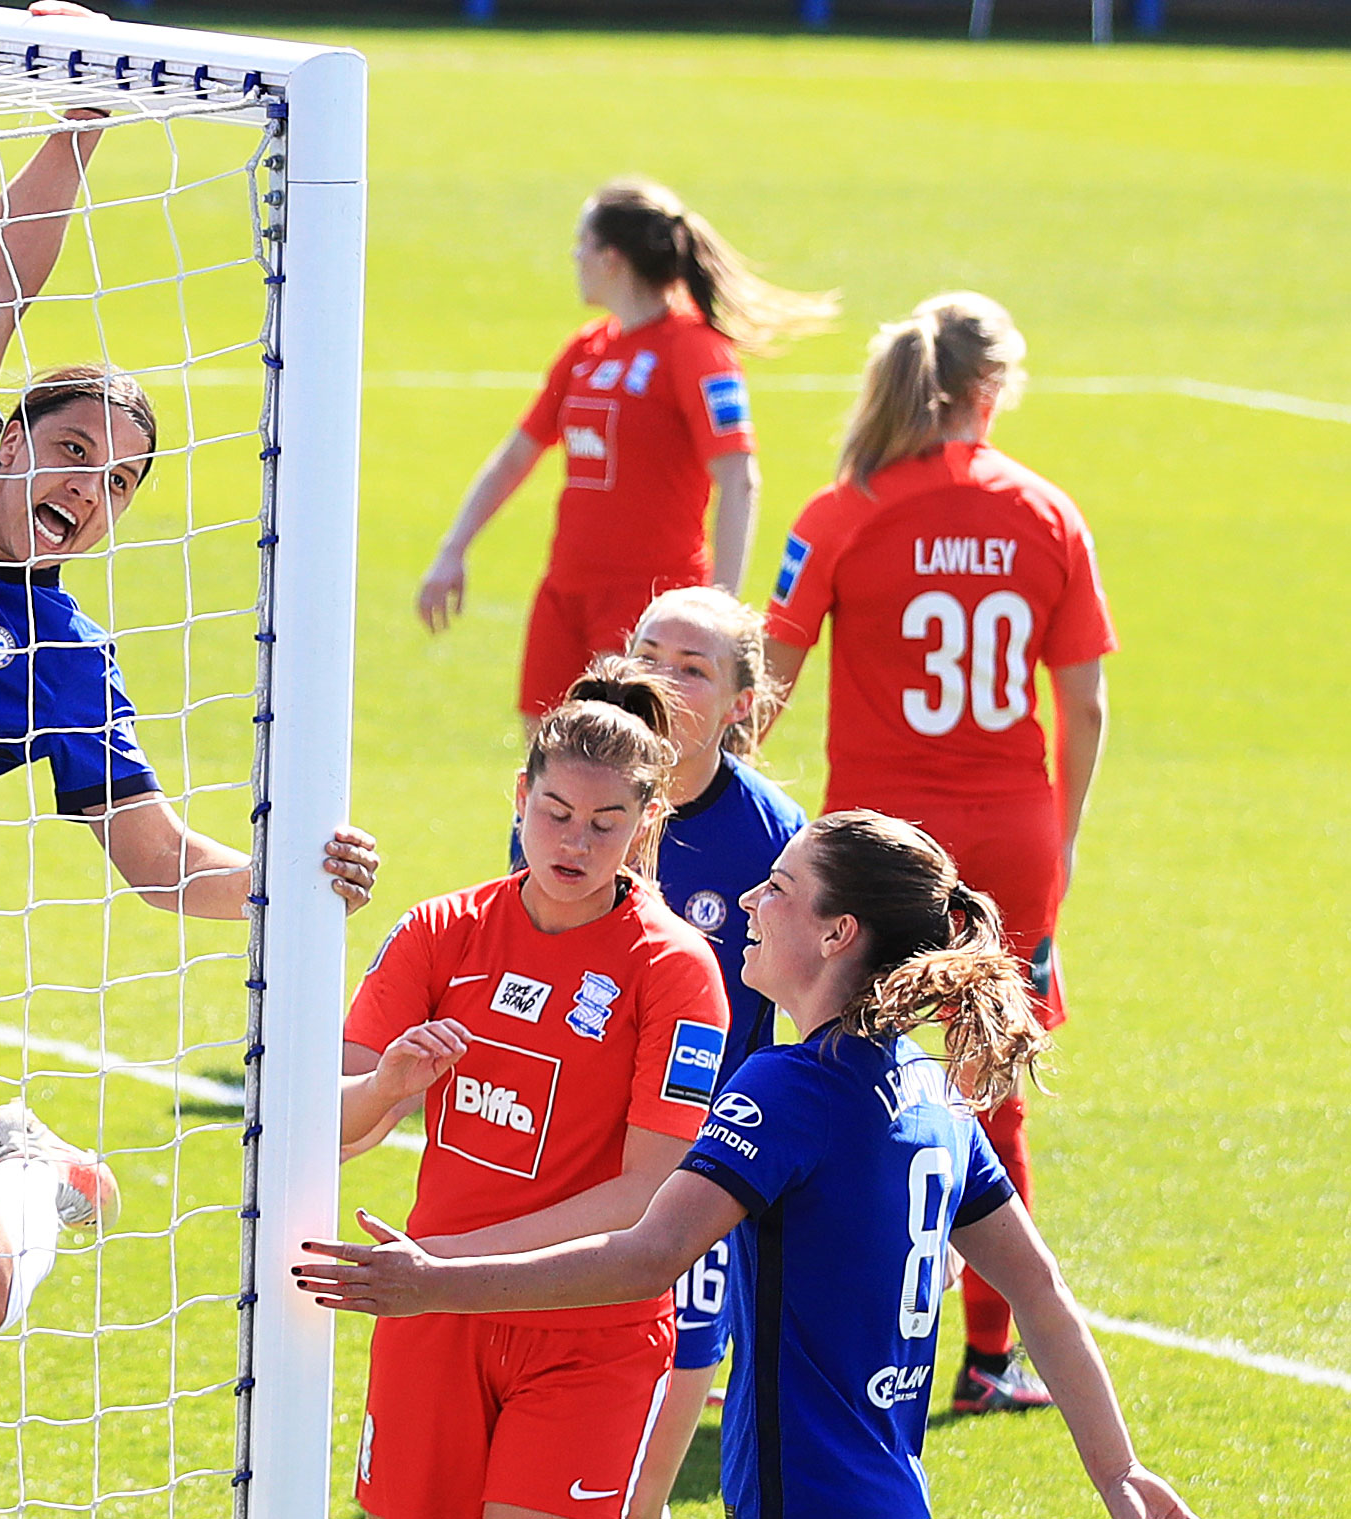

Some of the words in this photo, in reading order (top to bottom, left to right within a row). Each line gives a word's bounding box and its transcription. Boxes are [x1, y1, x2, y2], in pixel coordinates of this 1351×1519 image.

[914, 537, 1016, 576] LAWLEY
[901, 590, 1033, 737] 30
[675, 1240, 729, 1314] 16
[899, 1147, 953, 1340] 8
